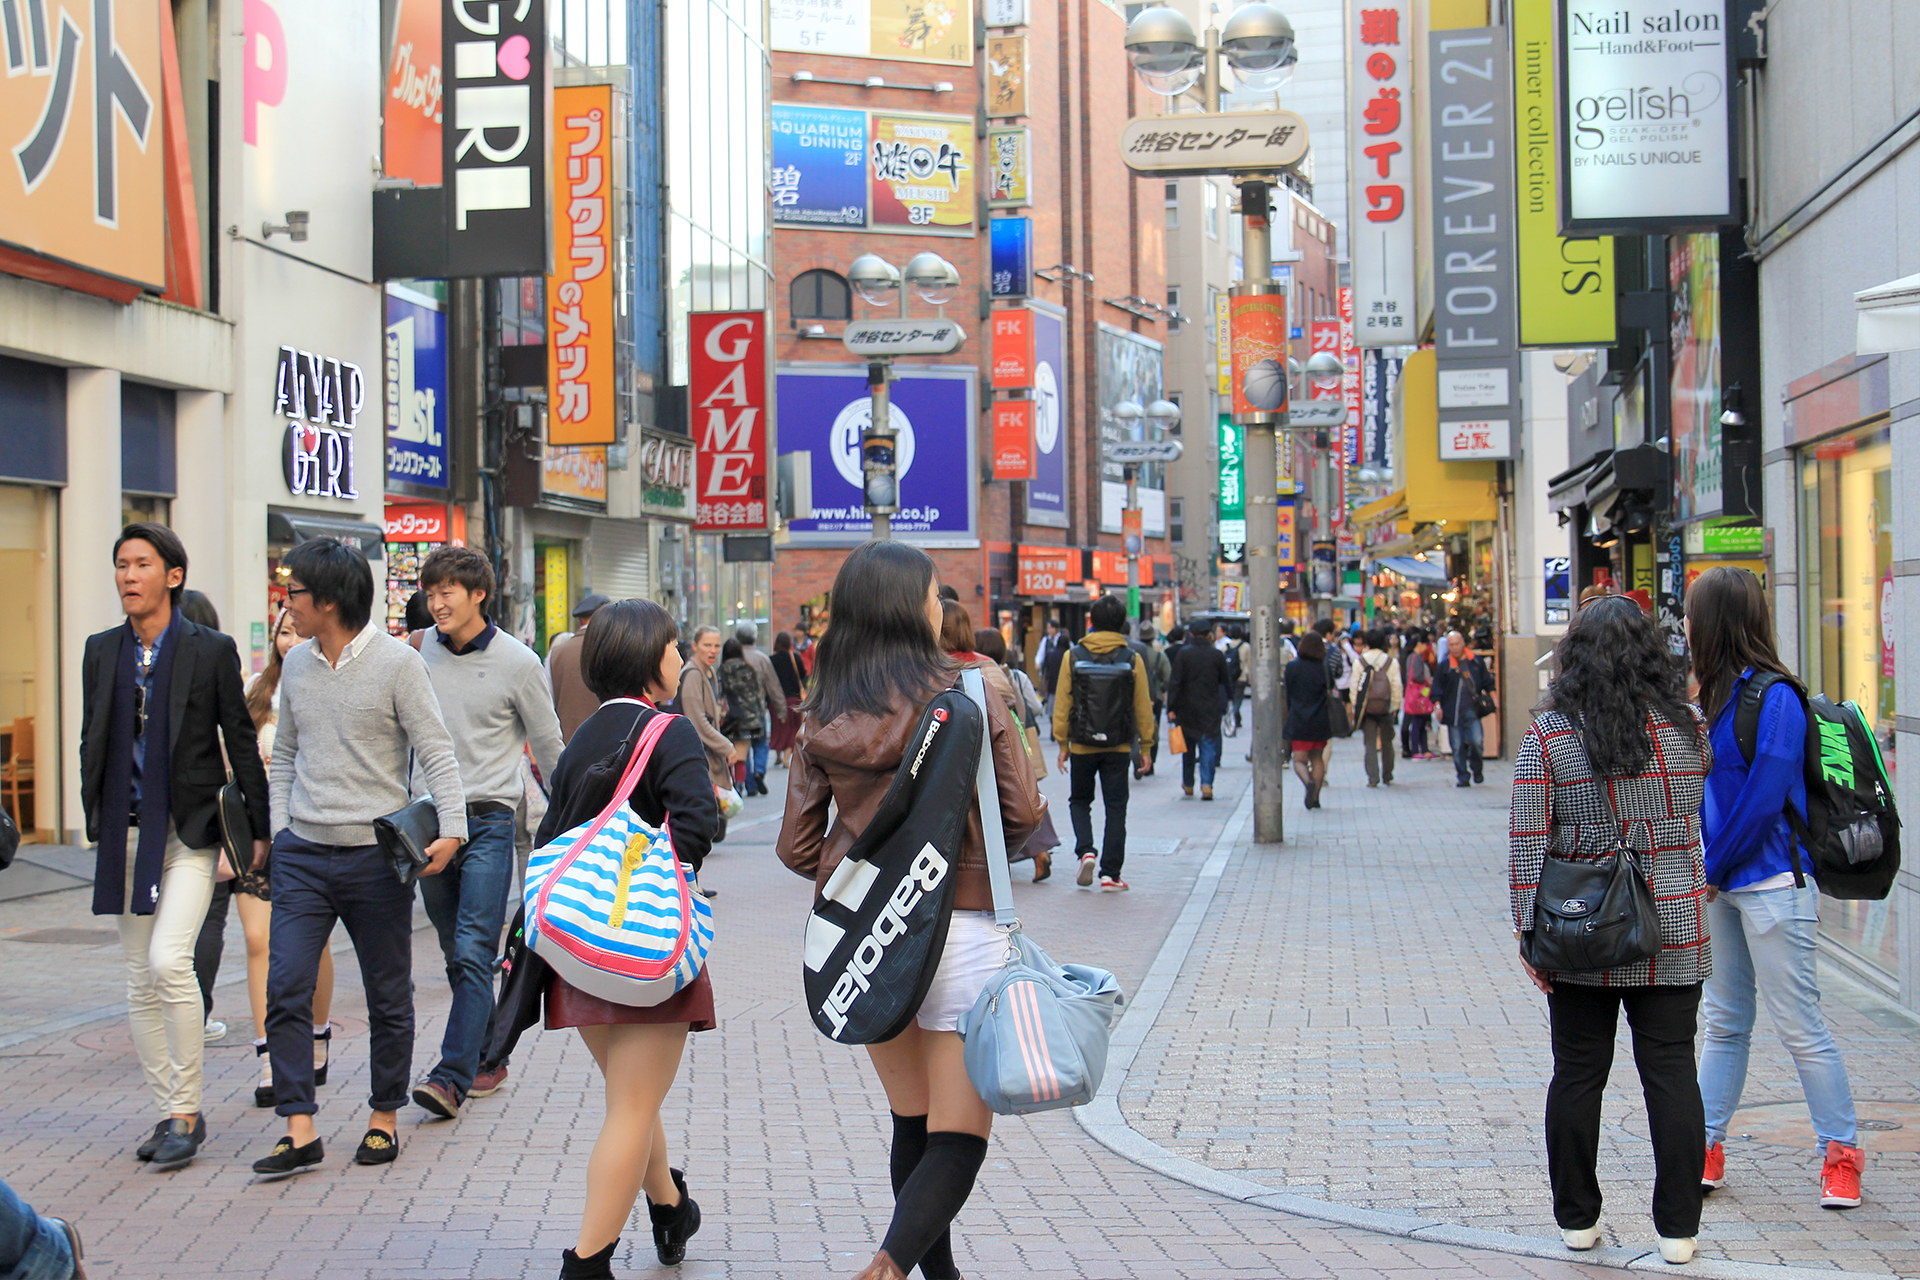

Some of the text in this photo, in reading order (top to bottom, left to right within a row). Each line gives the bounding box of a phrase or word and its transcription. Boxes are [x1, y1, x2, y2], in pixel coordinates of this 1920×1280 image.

[1572, 9, 1721, 36] Nail salon
[1440, 36, 1494, 85] 21
[1599, 39, 1695, 56] Hand&Foot
[1525, 40, 1550, 214] inner collection
[1574, 86, 1690, 151] gelish
[1609, 125, 1688, 135] SOAK-OFF
[800, 135, 863, 151] DINING
[1129, 124, 1297, 154] 渋谷センター街
[1609, 133, 1689, 144] GEL POLISH
[844, 152, 863, 166] 2F
[1574, 150, 1702, 168] BY NAILS UNIQUE
[909, 205, 935, 225] 3F
[1441, 101, 1499, 349] FOREVER
[1371, 302, 1397, 313] 渋谷
[850, 326, 952, 345] 渋谷センター街
[996, 320, 1022, 336] FK
[1366, 316, 1403, 328] 2号店
[275, 344, 366, 430] ANAP
[387, 334, 400, 426] BOOK
[700, 318, 761, 498] GAME
[999, 412, 1024, 428] FK
[388, 446, 443, 480] ブックファースト
[642, 438, 692, 489] GAME
[696, 502, 765, 525] 渋谷会館
[910, 720, 942, 780] Babolat
[1814, 713, 1856, 791] NIKE
[820, 841, 950, 1041] Babolat
